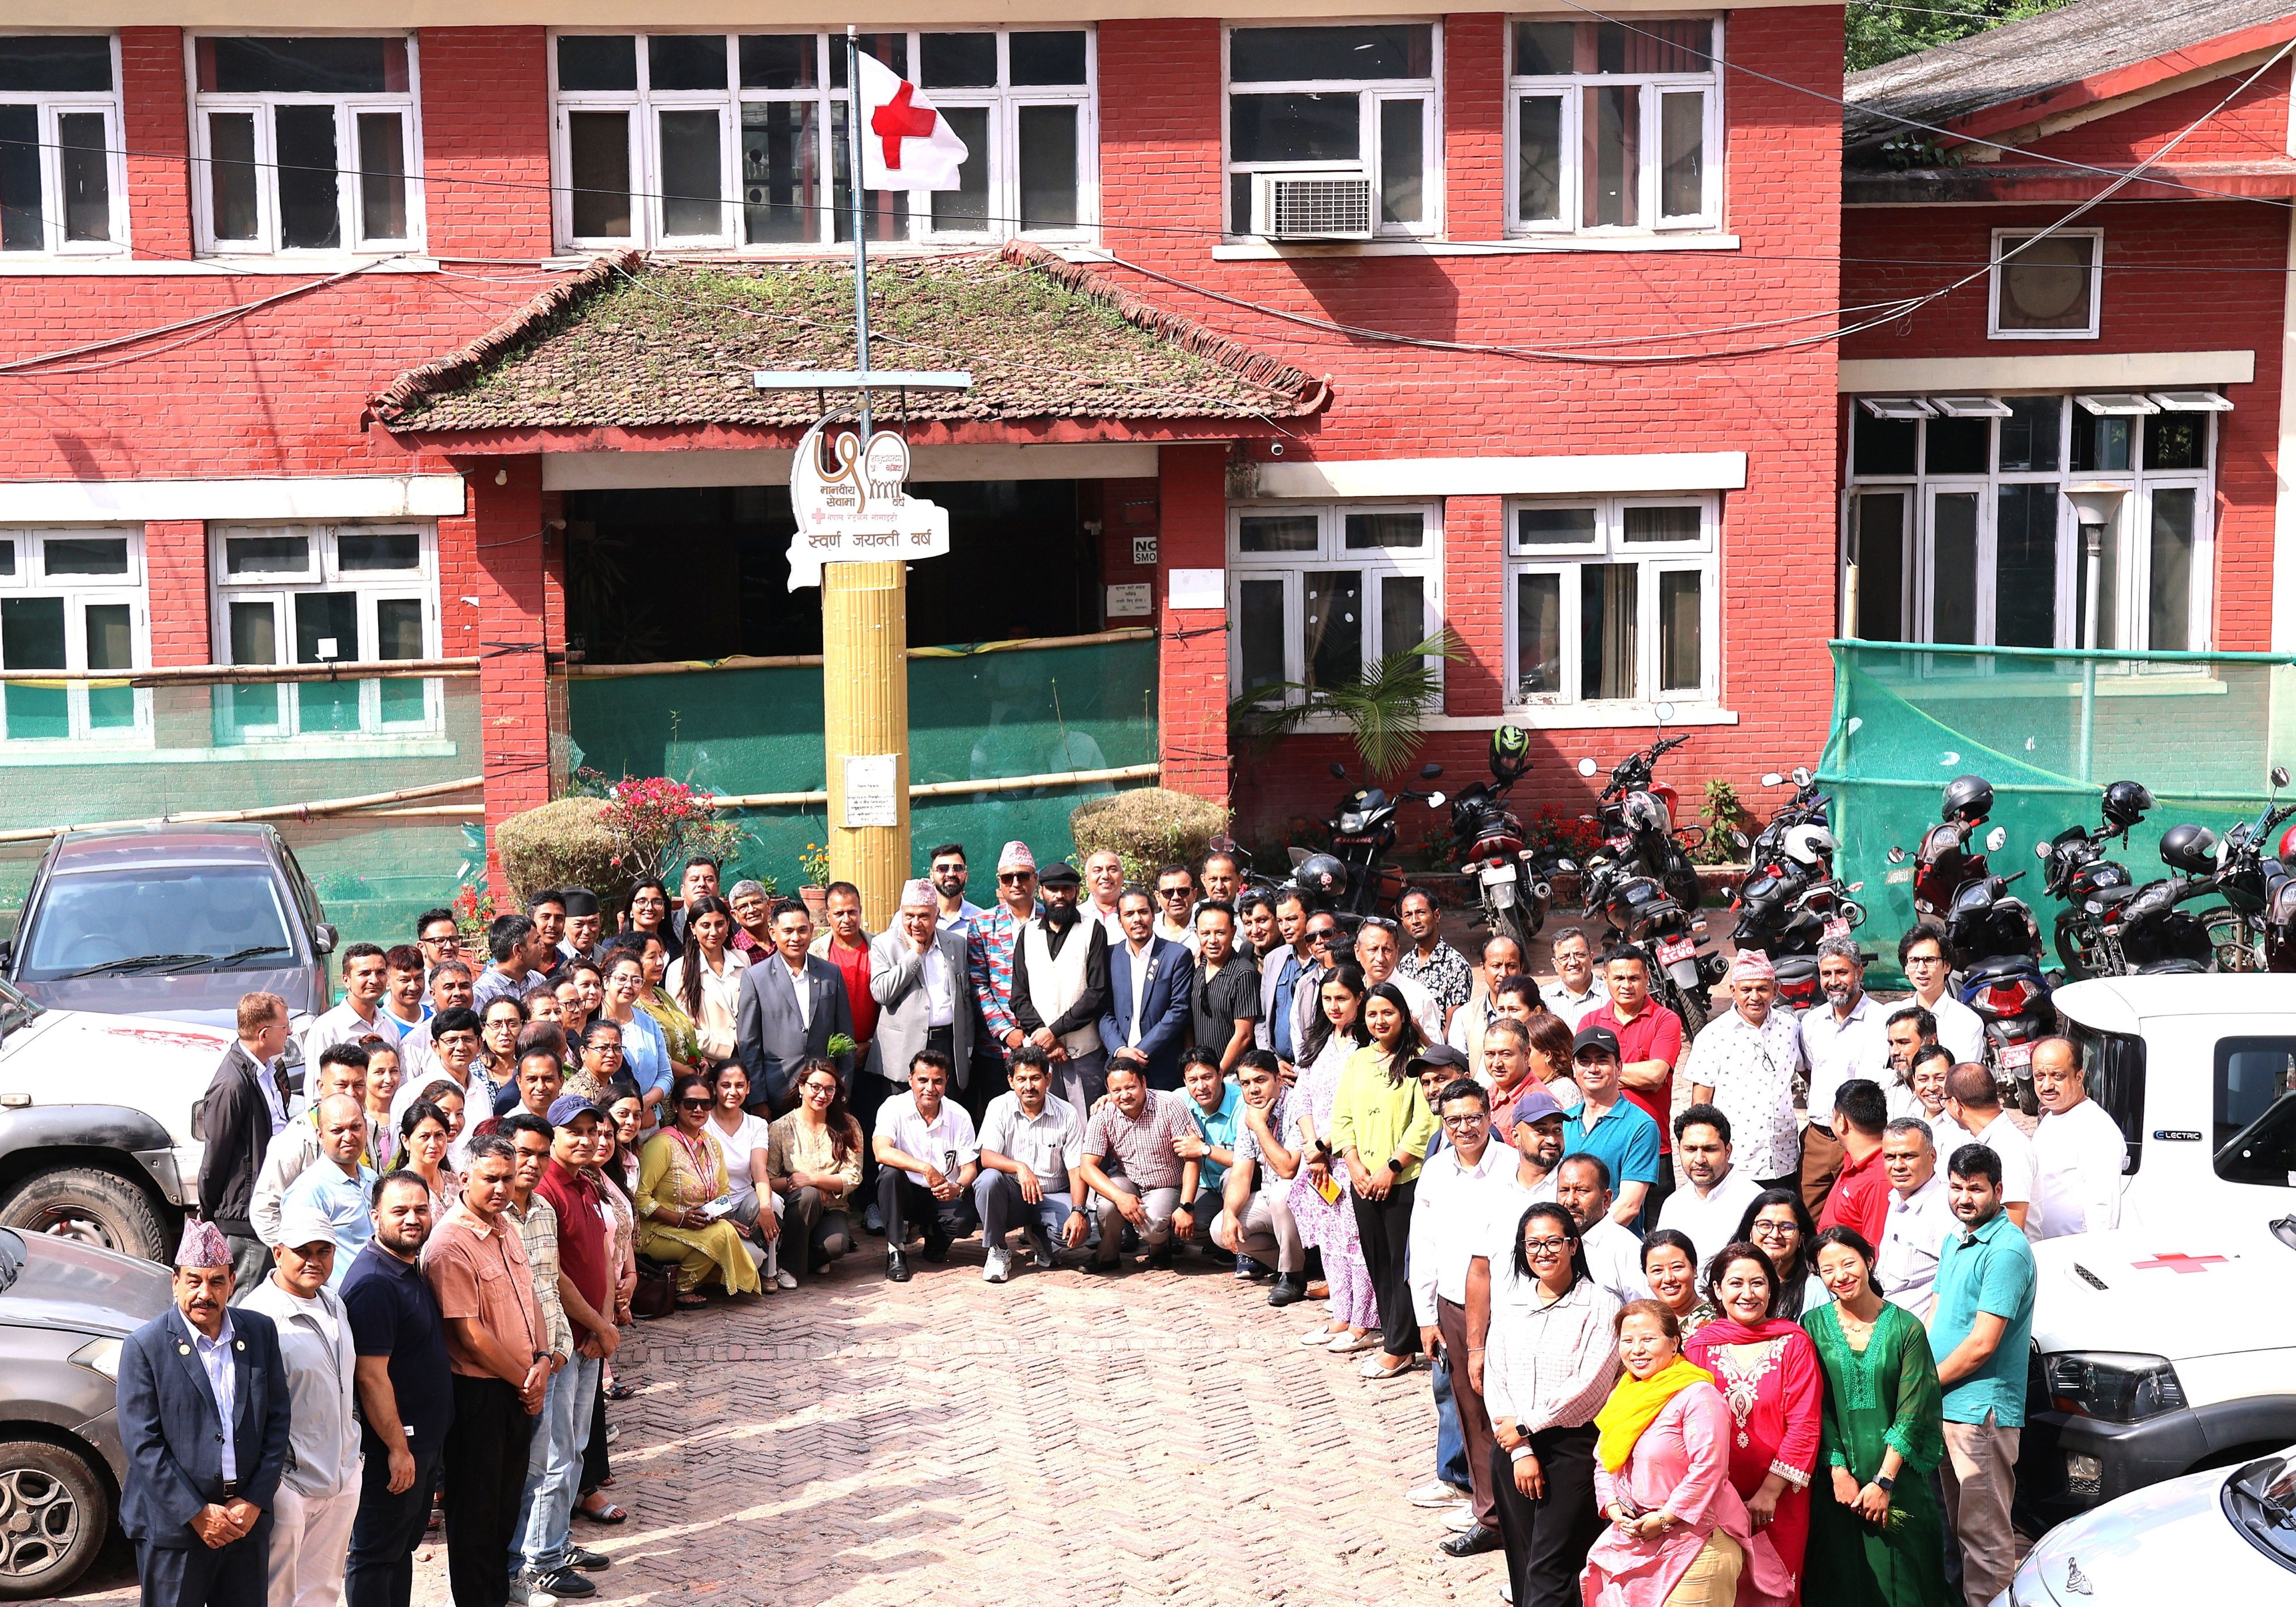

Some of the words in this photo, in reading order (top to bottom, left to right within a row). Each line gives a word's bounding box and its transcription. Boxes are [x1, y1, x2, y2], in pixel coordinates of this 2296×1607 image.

[820, 484, 855, 495] मानवीय
[827, 495, 855, 507] सेवामा
[892, 496, 905, 507] वर्ष
[808, 531, 841, 548] स्वर्ण
[853, 530, 900, 547] जयन्ती
[911, 529, 932, 546] वर्ष
[2156, 1131, 2200, 1139] ELECTRIC
